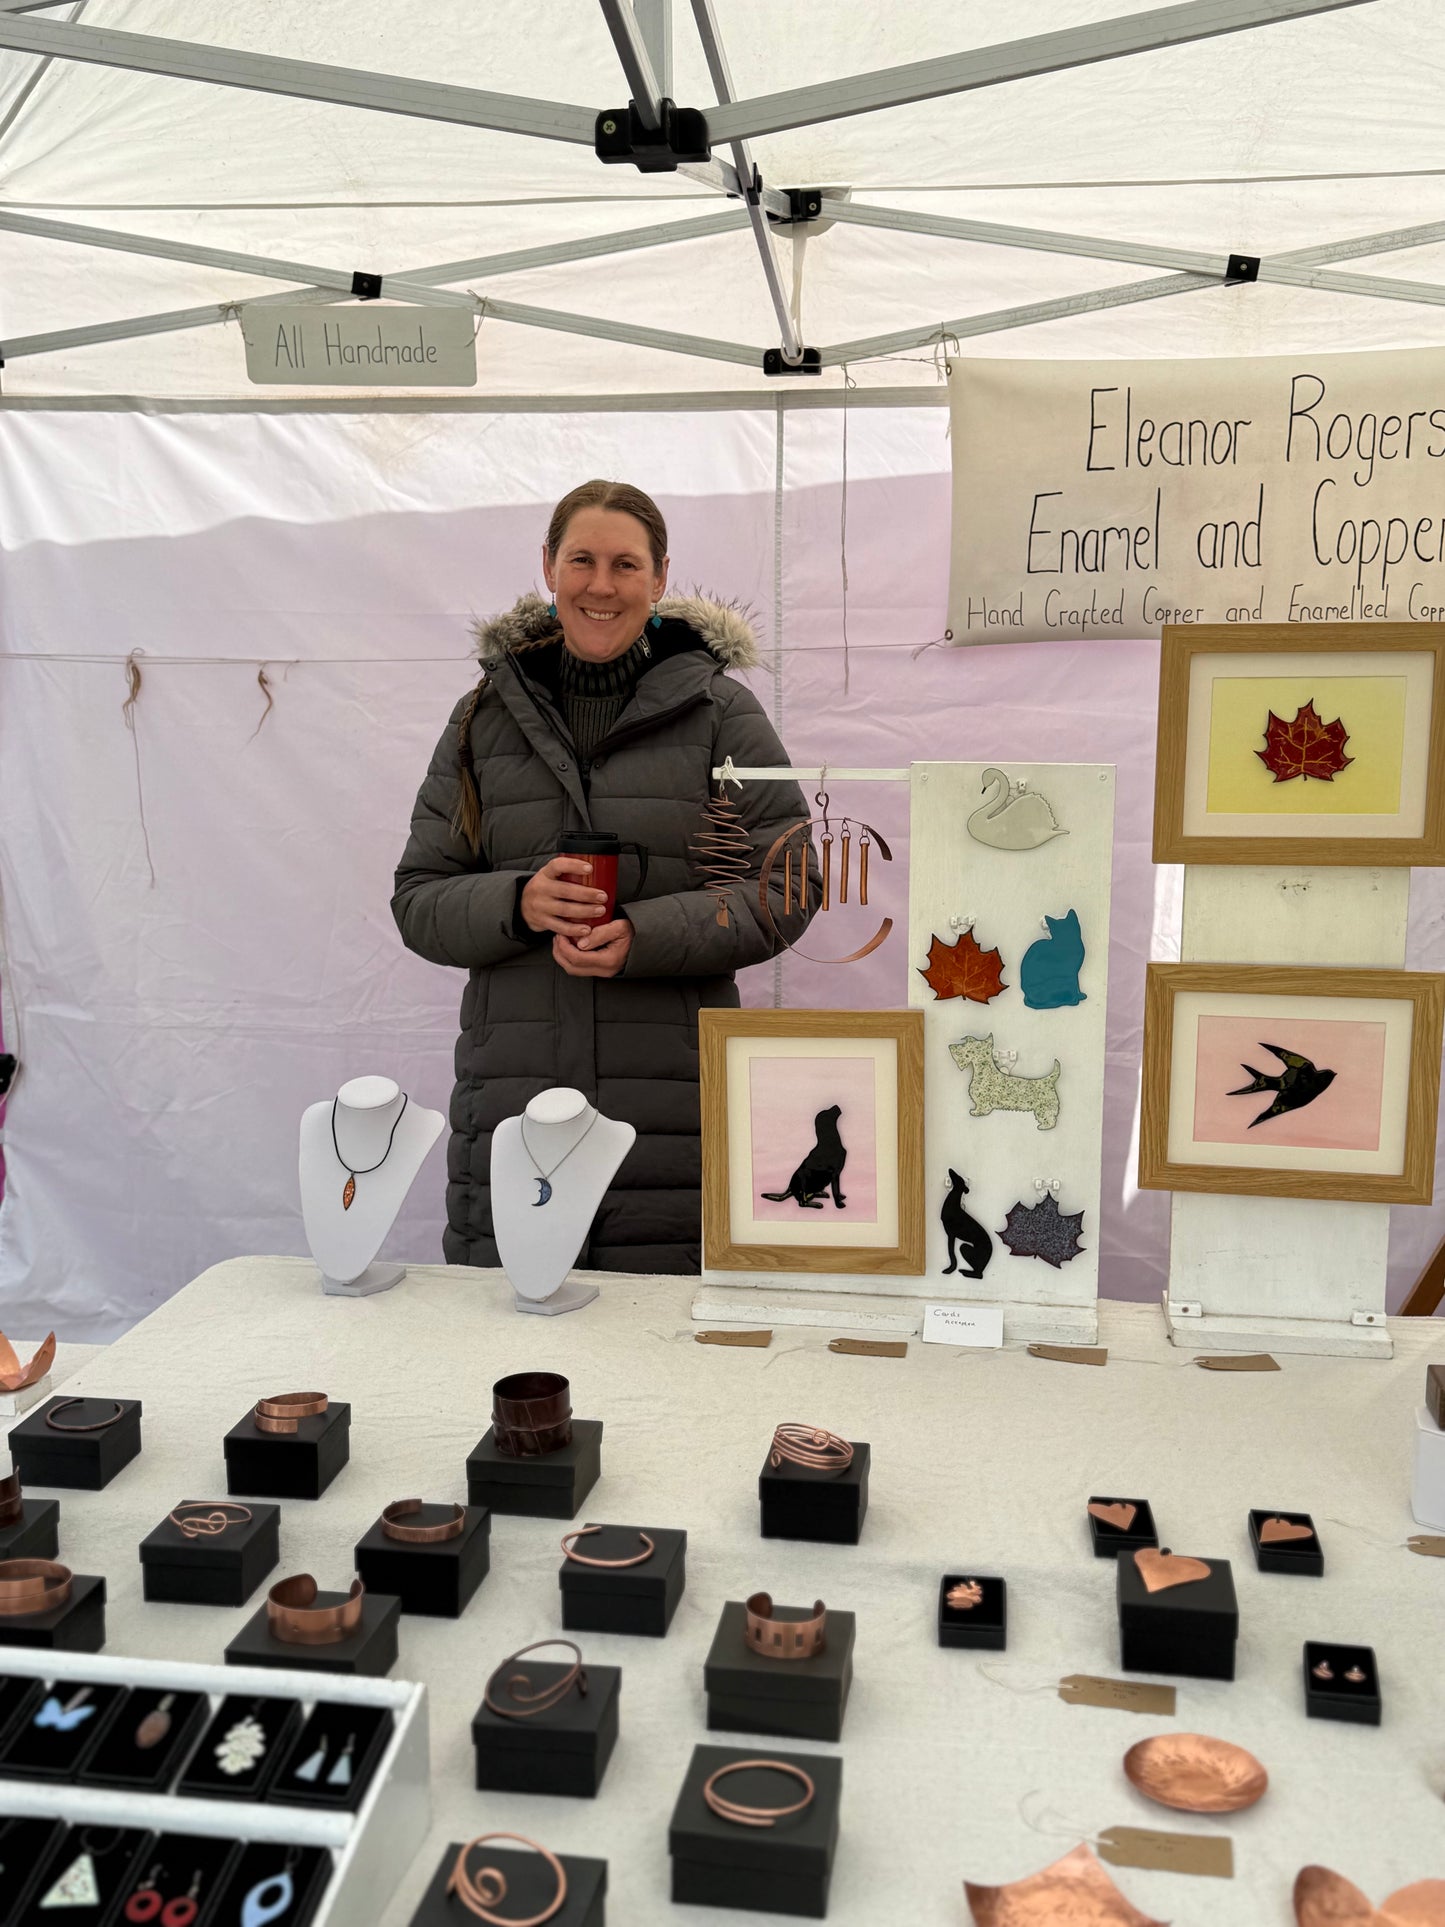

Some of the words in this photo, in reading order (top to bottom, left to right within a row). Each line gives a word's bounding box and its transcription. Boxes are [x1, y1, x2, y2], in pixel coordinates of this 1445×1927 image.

[275, 323, 306, 369] All
[324, 322, 438, 367] Handmade
[1087, 386, 1252, 471] Eleanor
[1286, 374, 1445, 487] Rogers
[1027, 487, 1161, 573] Enamel
[1197, 483, 1264, 569] and
[967, 591, 1025, 629] Hand
[1044, 588, 1125, 632] Crafted
[1142, 585, 1204, 624] Copper
[1225, 585, 1265, 622] and
[1287, 583, 1389, 622] Enamelled
